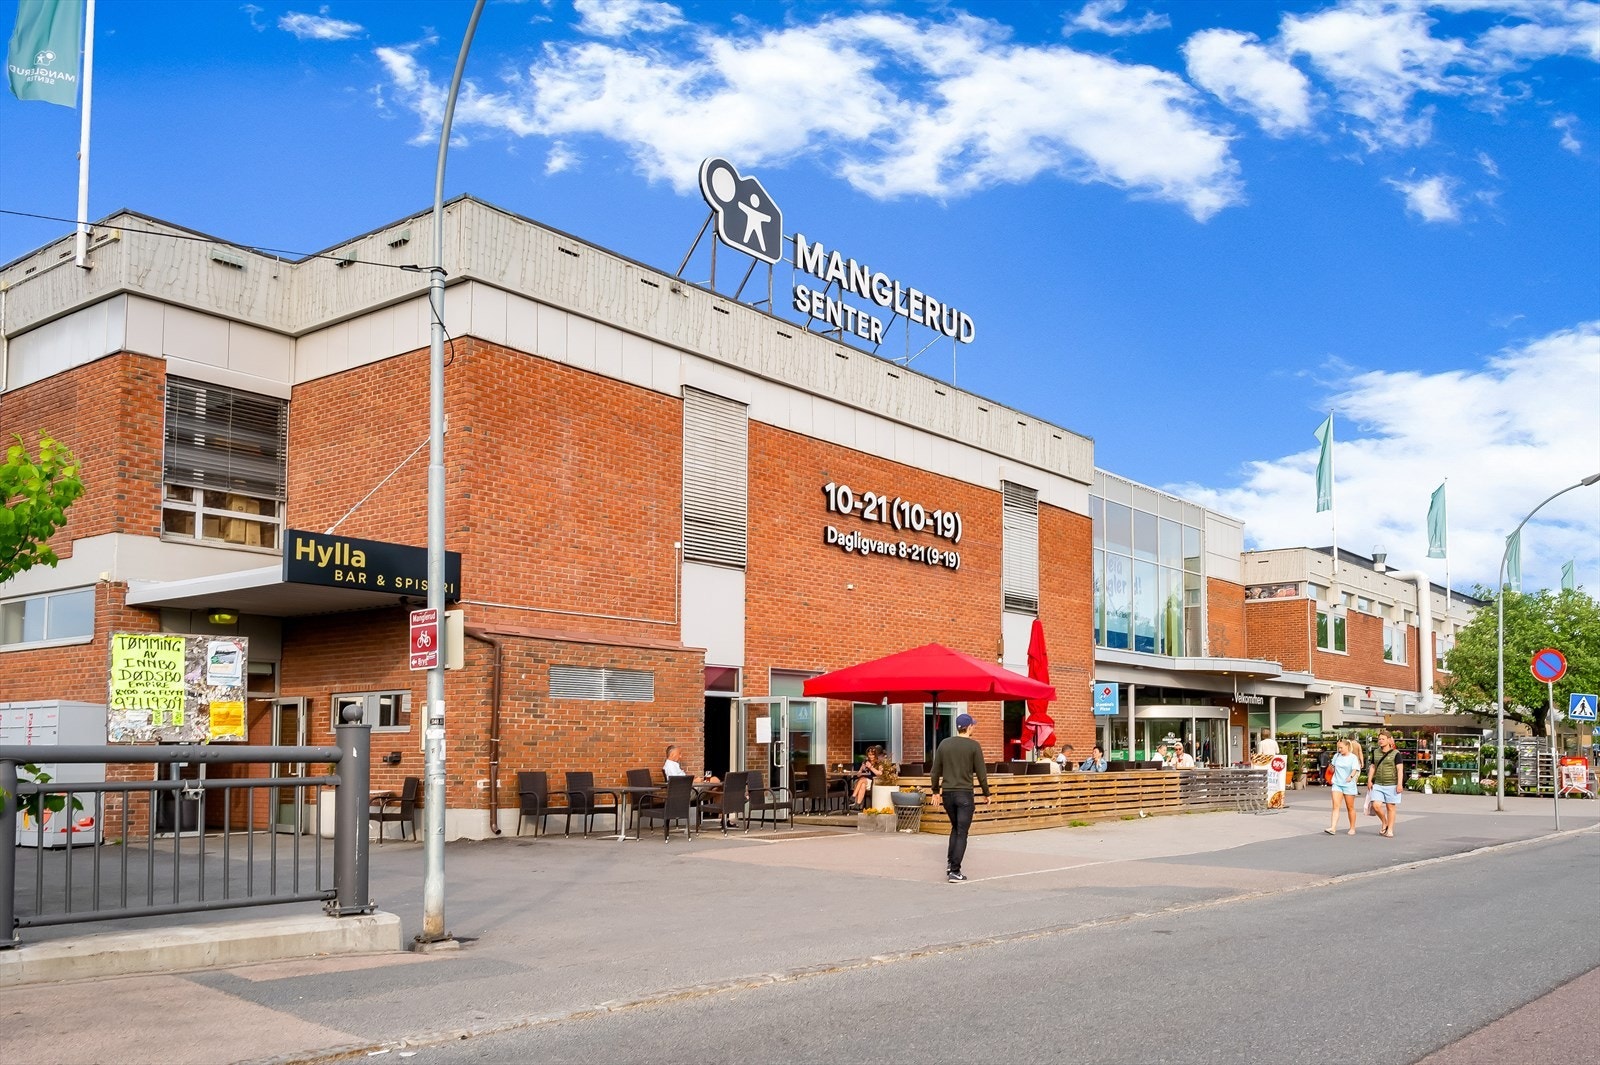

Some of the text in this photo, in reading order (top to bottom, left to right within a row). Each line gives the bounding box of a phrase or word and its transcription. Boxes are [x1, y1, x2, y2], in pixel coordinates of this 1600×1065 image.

[793, 233, 975, 344] MANGLERUD
[793, 284, 883, 344] SENTER
[823, 482, 963, 544] 10-21 (10-19)
[296, 537, 366, 568] Hylla
[826, 525, 961, 570] Dagligvare 8-21 (9-19)
[335, 569, 454, 594] BAR & SPISRI
[412, 611, 436, 623] Manglerud
[123, 657, 177, 671] INNBO
[144, 650, 157, 659] AV
[118, 668, 182, 683] DØDSBO
[115, 696, 182, 711] 97119309
